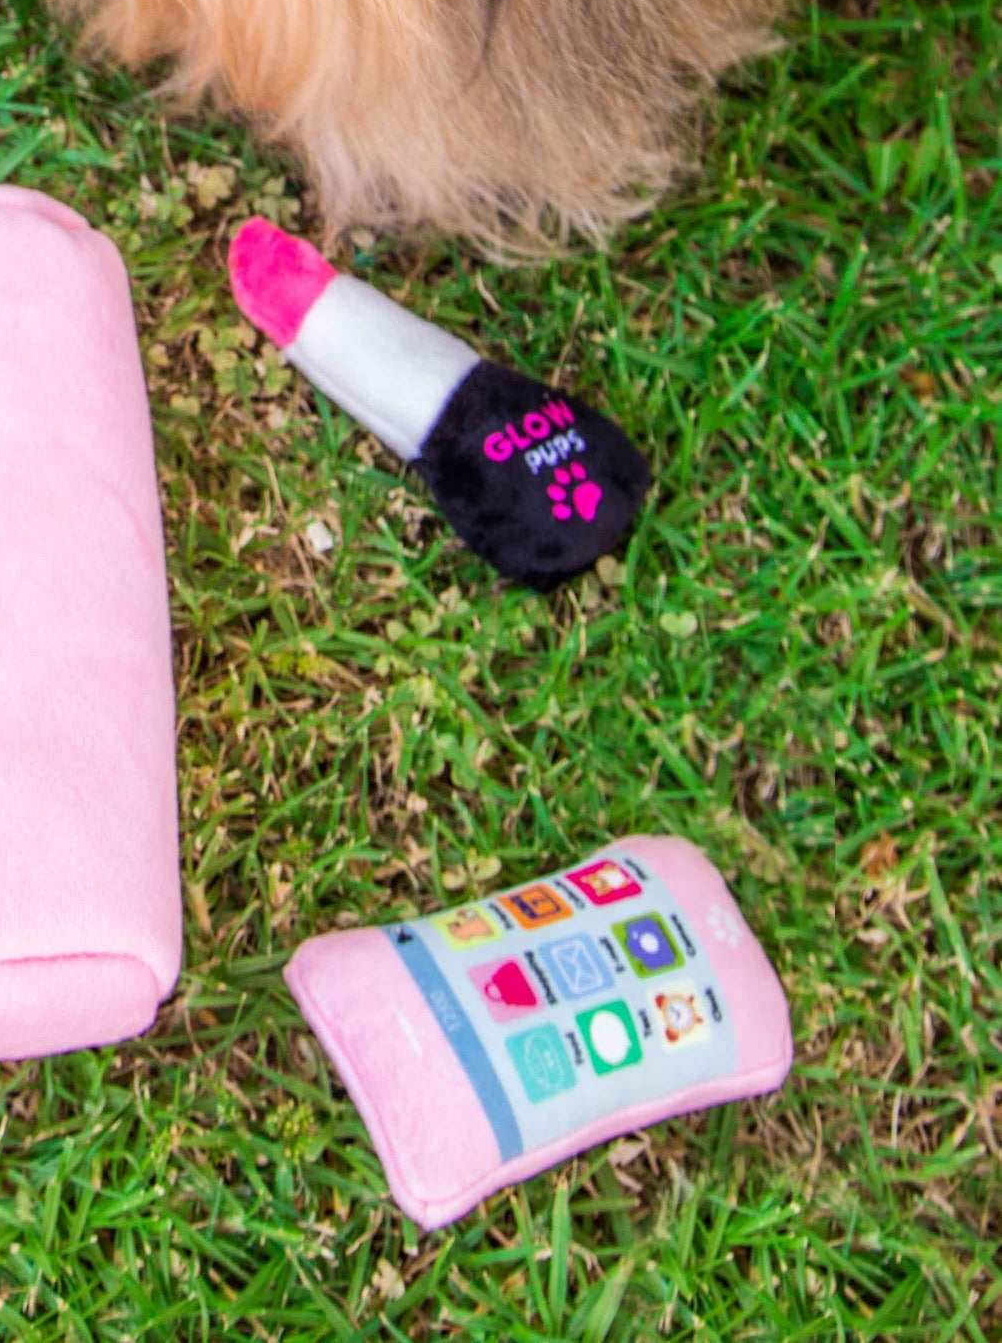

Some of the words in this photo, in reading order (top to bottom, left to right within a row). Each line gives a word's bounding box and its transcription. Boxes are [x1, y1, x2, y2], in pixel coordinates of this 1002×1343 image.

[483, 400, 575, 463] GLOW
[523, 429, 586, 476] PUPS
[524, 949, 558, 1005] Shopping
